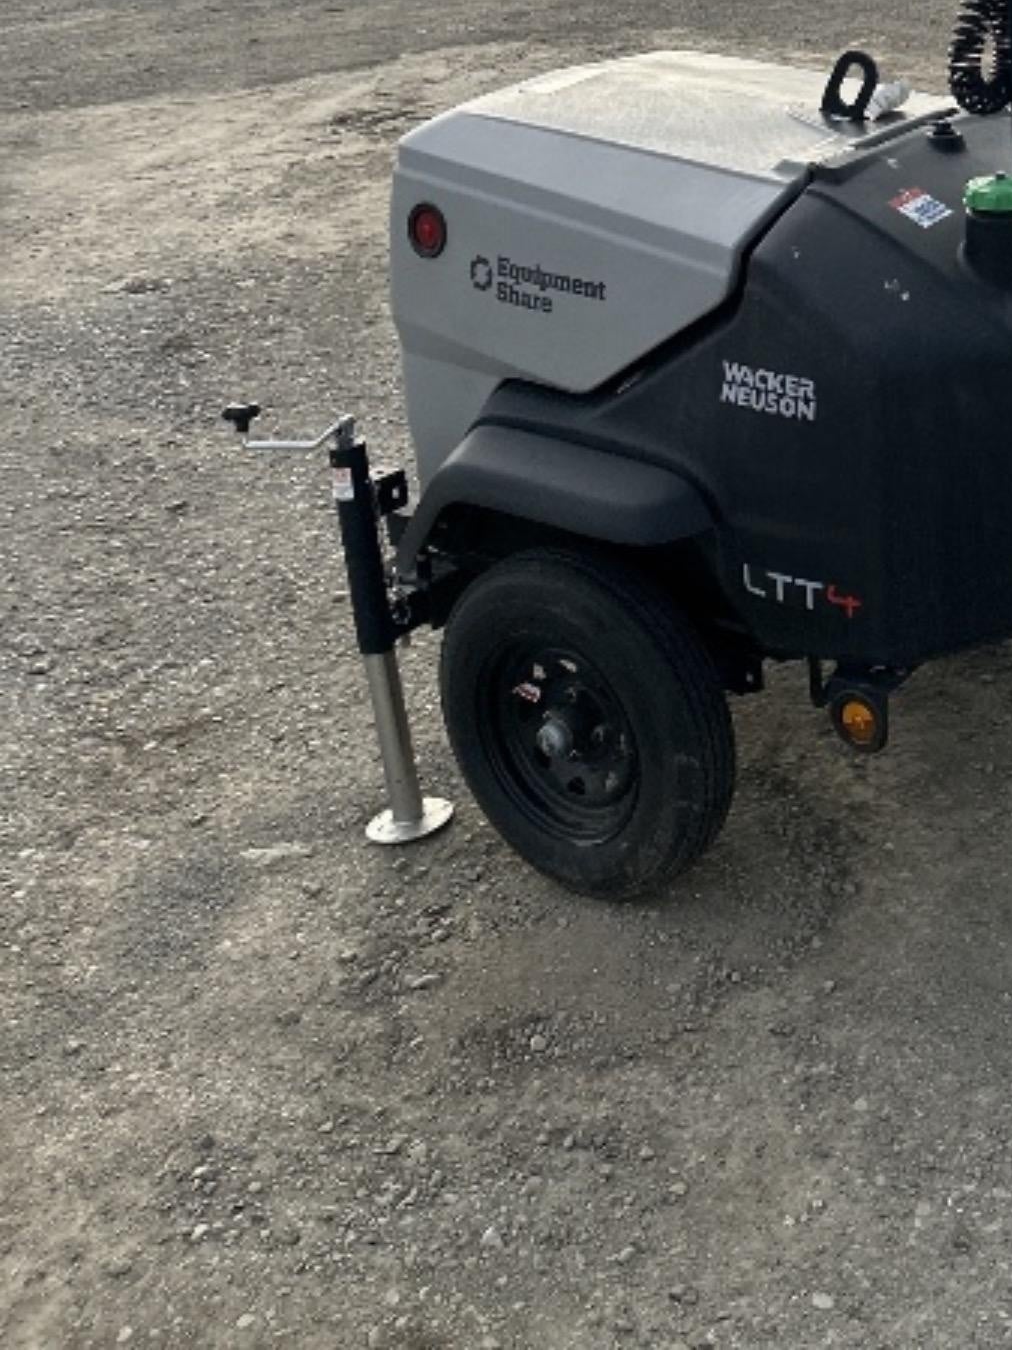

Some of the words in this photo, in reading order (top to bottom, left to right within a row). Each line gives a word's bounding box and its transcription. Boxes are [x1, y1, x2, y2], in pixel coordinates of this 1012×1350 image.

[496, 282, 553, 313] Share
[497, 255, 606, 300] Equipment
[721, 359, 816, 400] WACKER
[720, 382, 817, 421] NEUSON
